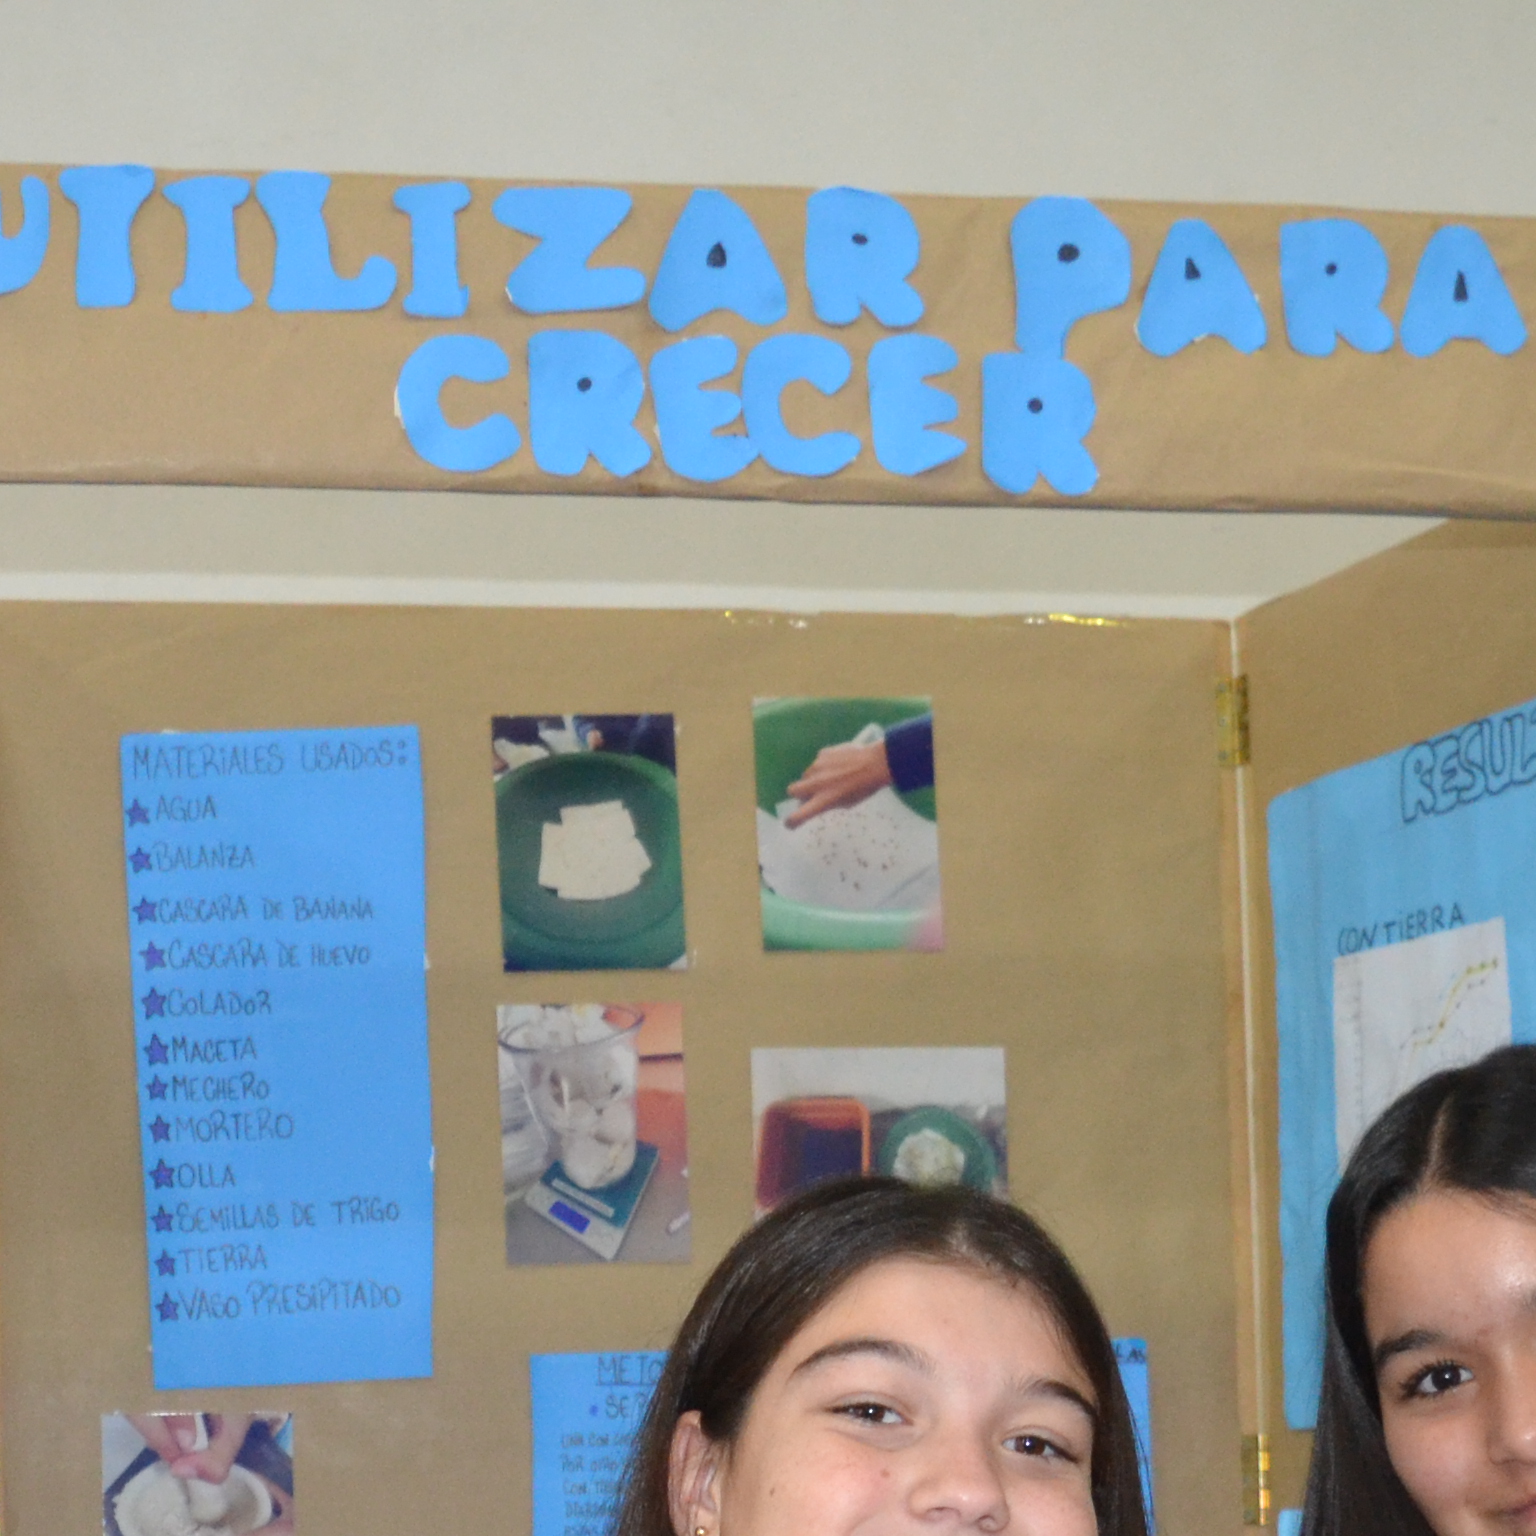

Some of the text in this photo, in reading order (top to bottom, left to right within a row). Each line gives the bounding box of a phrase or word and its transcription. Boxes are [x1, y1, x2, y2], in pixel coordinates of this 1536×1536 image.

[1010, 195, 1528, 358] PARA
[396, 328, 1100, 496] CRECER
[133, 744, 285, 780] MATERIALES
[156, 795, 218, 822] AGUA
[152, 840, 256, 872] BALANZA
[157, 894, 374, 924] CASCARA DE BANANA
[1337, 901, 1465, 957] CON TIERRA
[168, 937, 372, 969] CASCARA DE HUEVO
[166, 988, 274, 1016] COLADOR
[171, 1035, 258, 1064] MACETA
[172, 1071, 270, 1101] MECHERO
[174, 1108, 295, 1144] MORTERO
[177, 1163, 237, 1189] OLLA
[175, 1195, 401, 1234] SEMILLAS DE TRIGO
[178, 1243, 269, 1275] TIERRA
